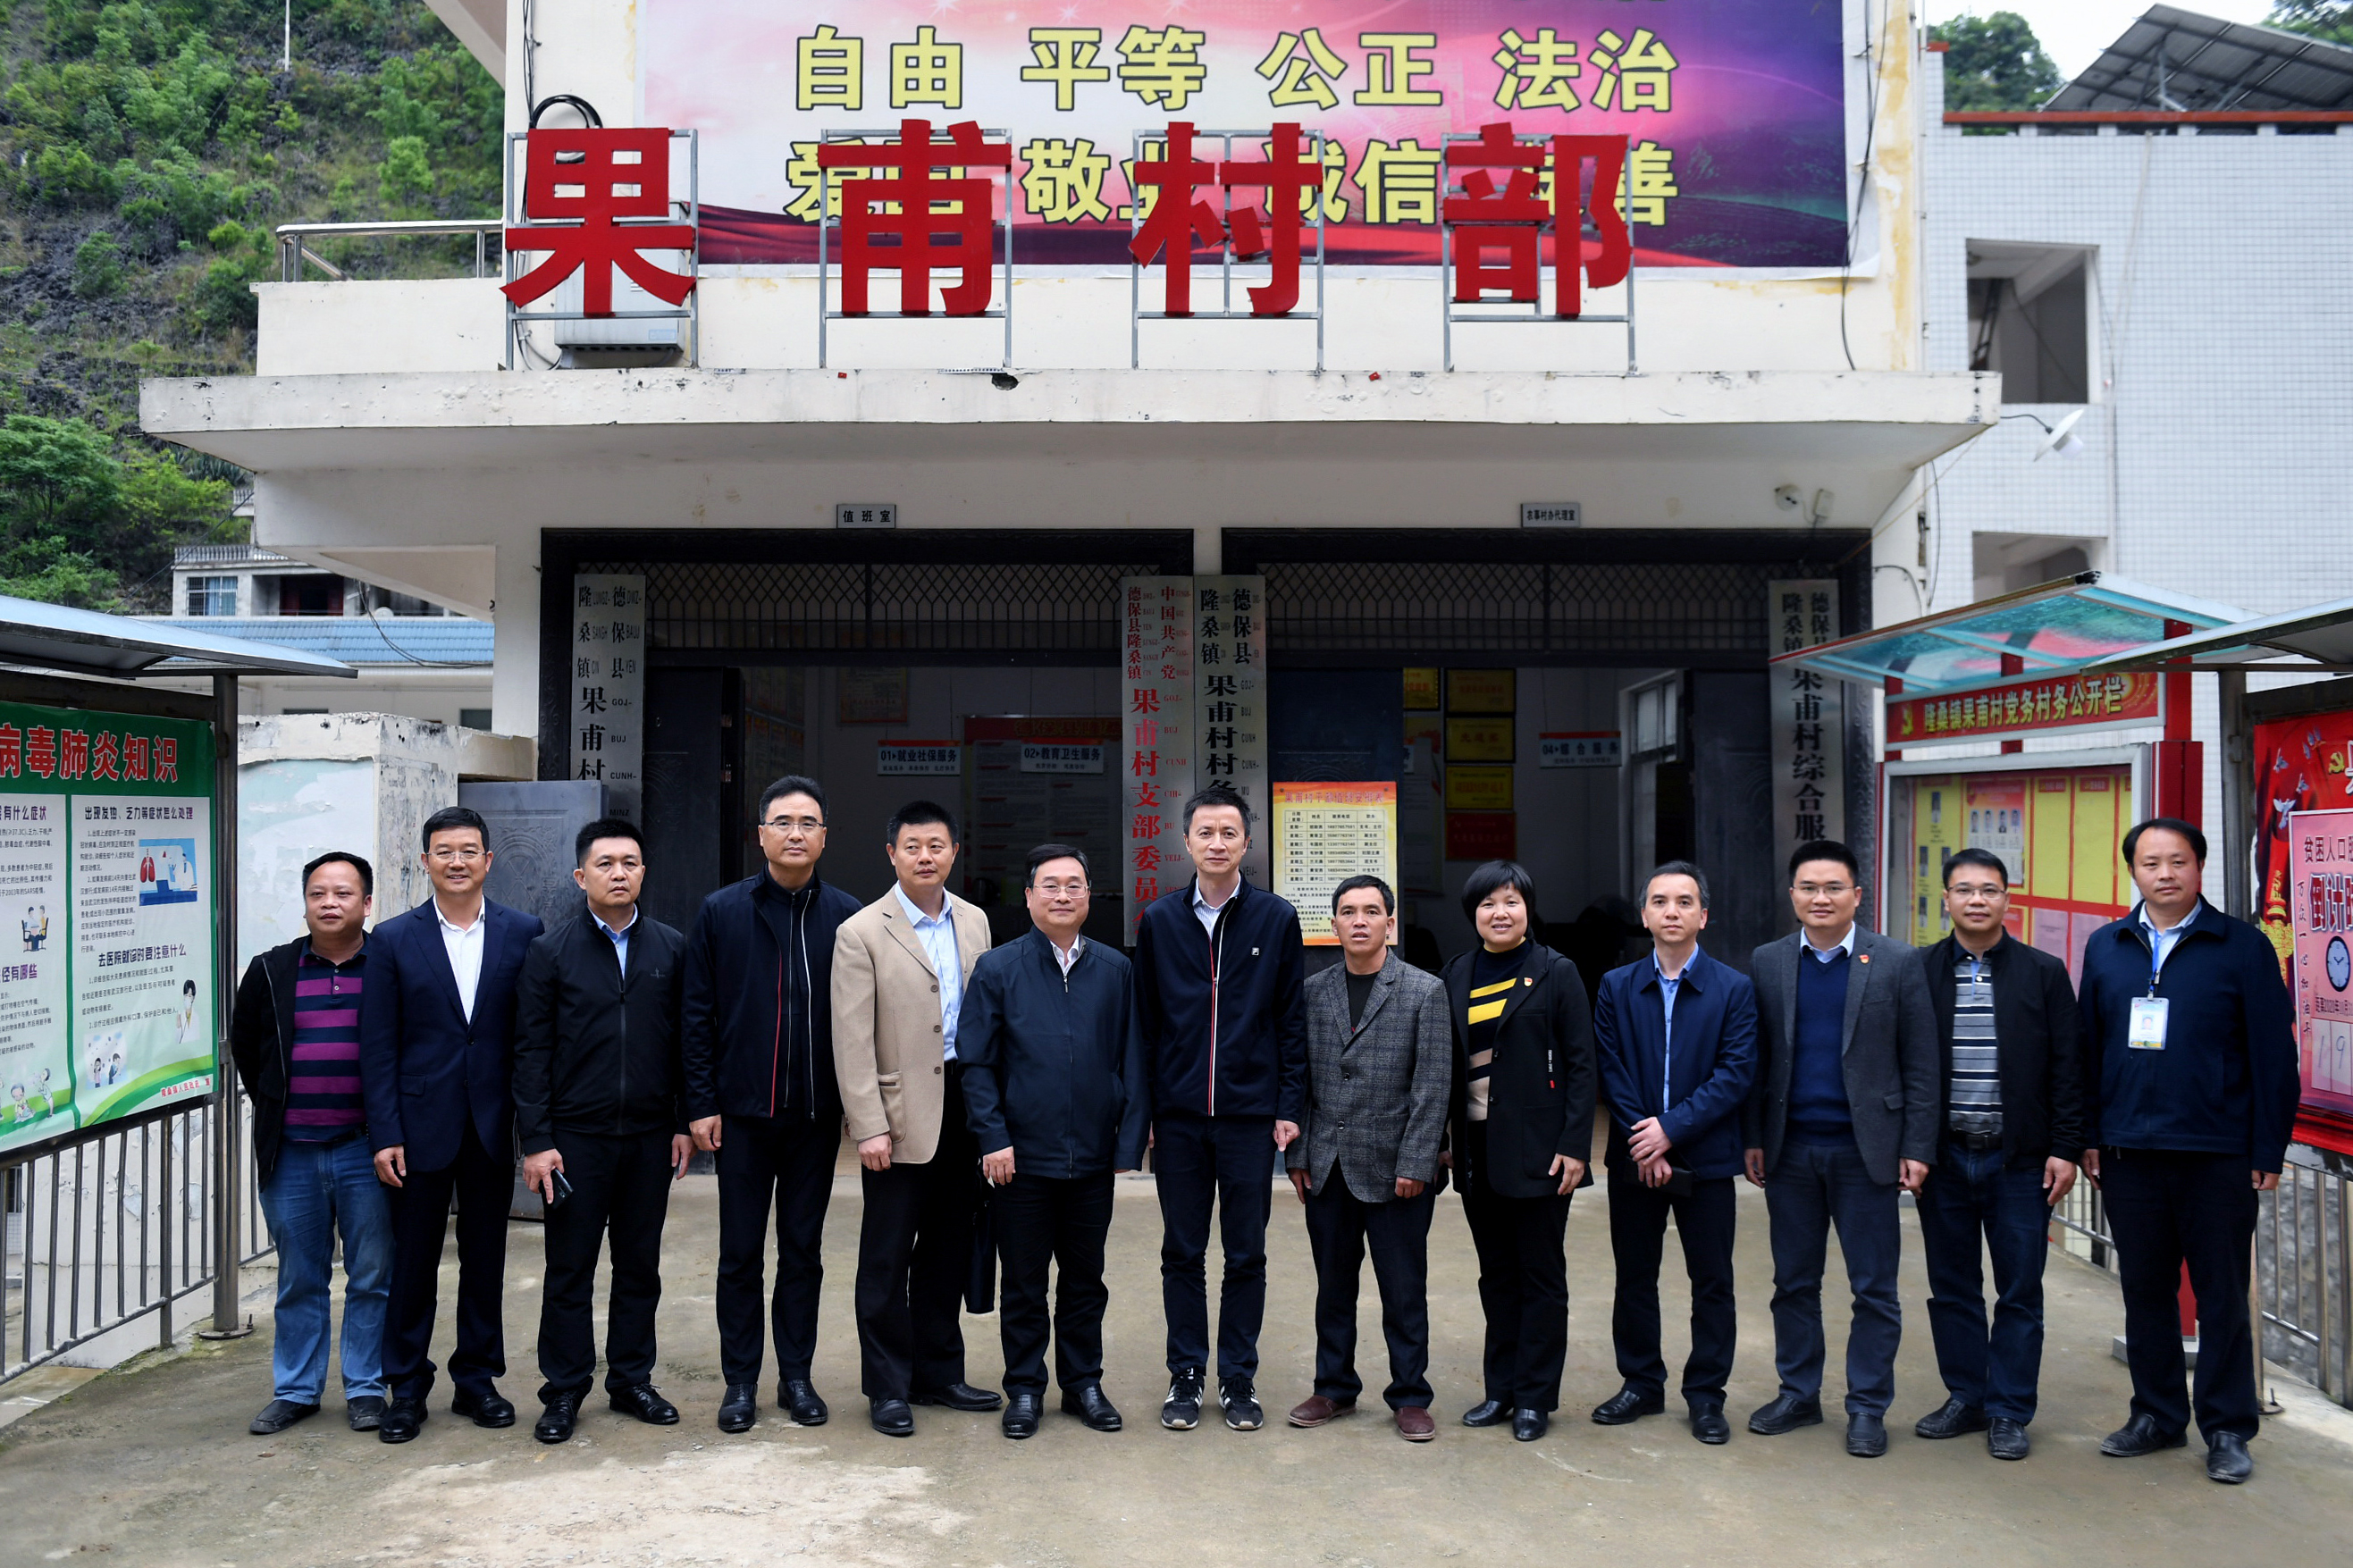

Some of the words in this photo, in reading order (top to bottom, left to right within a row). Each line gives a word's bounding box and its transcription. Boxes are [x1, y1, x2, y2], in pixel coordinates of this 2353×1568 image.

[796, 24, 963, 111] 自由
[1021, 24, 1207, 112] 平等
[1256, 27, 1443, 112] 公正
[1492, 27, 1679, 113] 法治
[786, 139, 963, 223] 爱
[1523, 140, 1678, 226] 善
[499, 119, 1633, 318] 果甫村部
[843, 510, 891, 523] 值班室
[577, 585, 592, 679] 隆桑镇
[610, 585, 626, 679] 德保县
[1127, 586, 1142, 679] 德保县隆桑镇
[1161, 586, 1176, 679] 中国共产党
[1200, 589, 1220, 665] 隆桑镇
[1233, 588, 1251, 665] 德保县
[612, 698, 633, 706] GOJ-
[1924, 676, 2122, 733] 隆桑镇果甫村党务村务公开栏
[0, 723, 178, 783] 病毒肺炎知识
[611, 735, 626, 743] BUJ
[881, 750, 891, 761] 01
[897, 750, 956, 762] 就业社保服务
[1024, 748, 1035, 759] 02
[1041, 747, 1100, 760] 教育卫生服务
[1165, 758, 1187, 766] CUNH
[1542, 744, 1553, 755] 04
[610, 772, 637, 780] CUNH-
[85, 806, 193, 820] 出现发热、乏力等症状怎么处理
[98, 943, 187, 967] 去医院就诊时要注意什么
